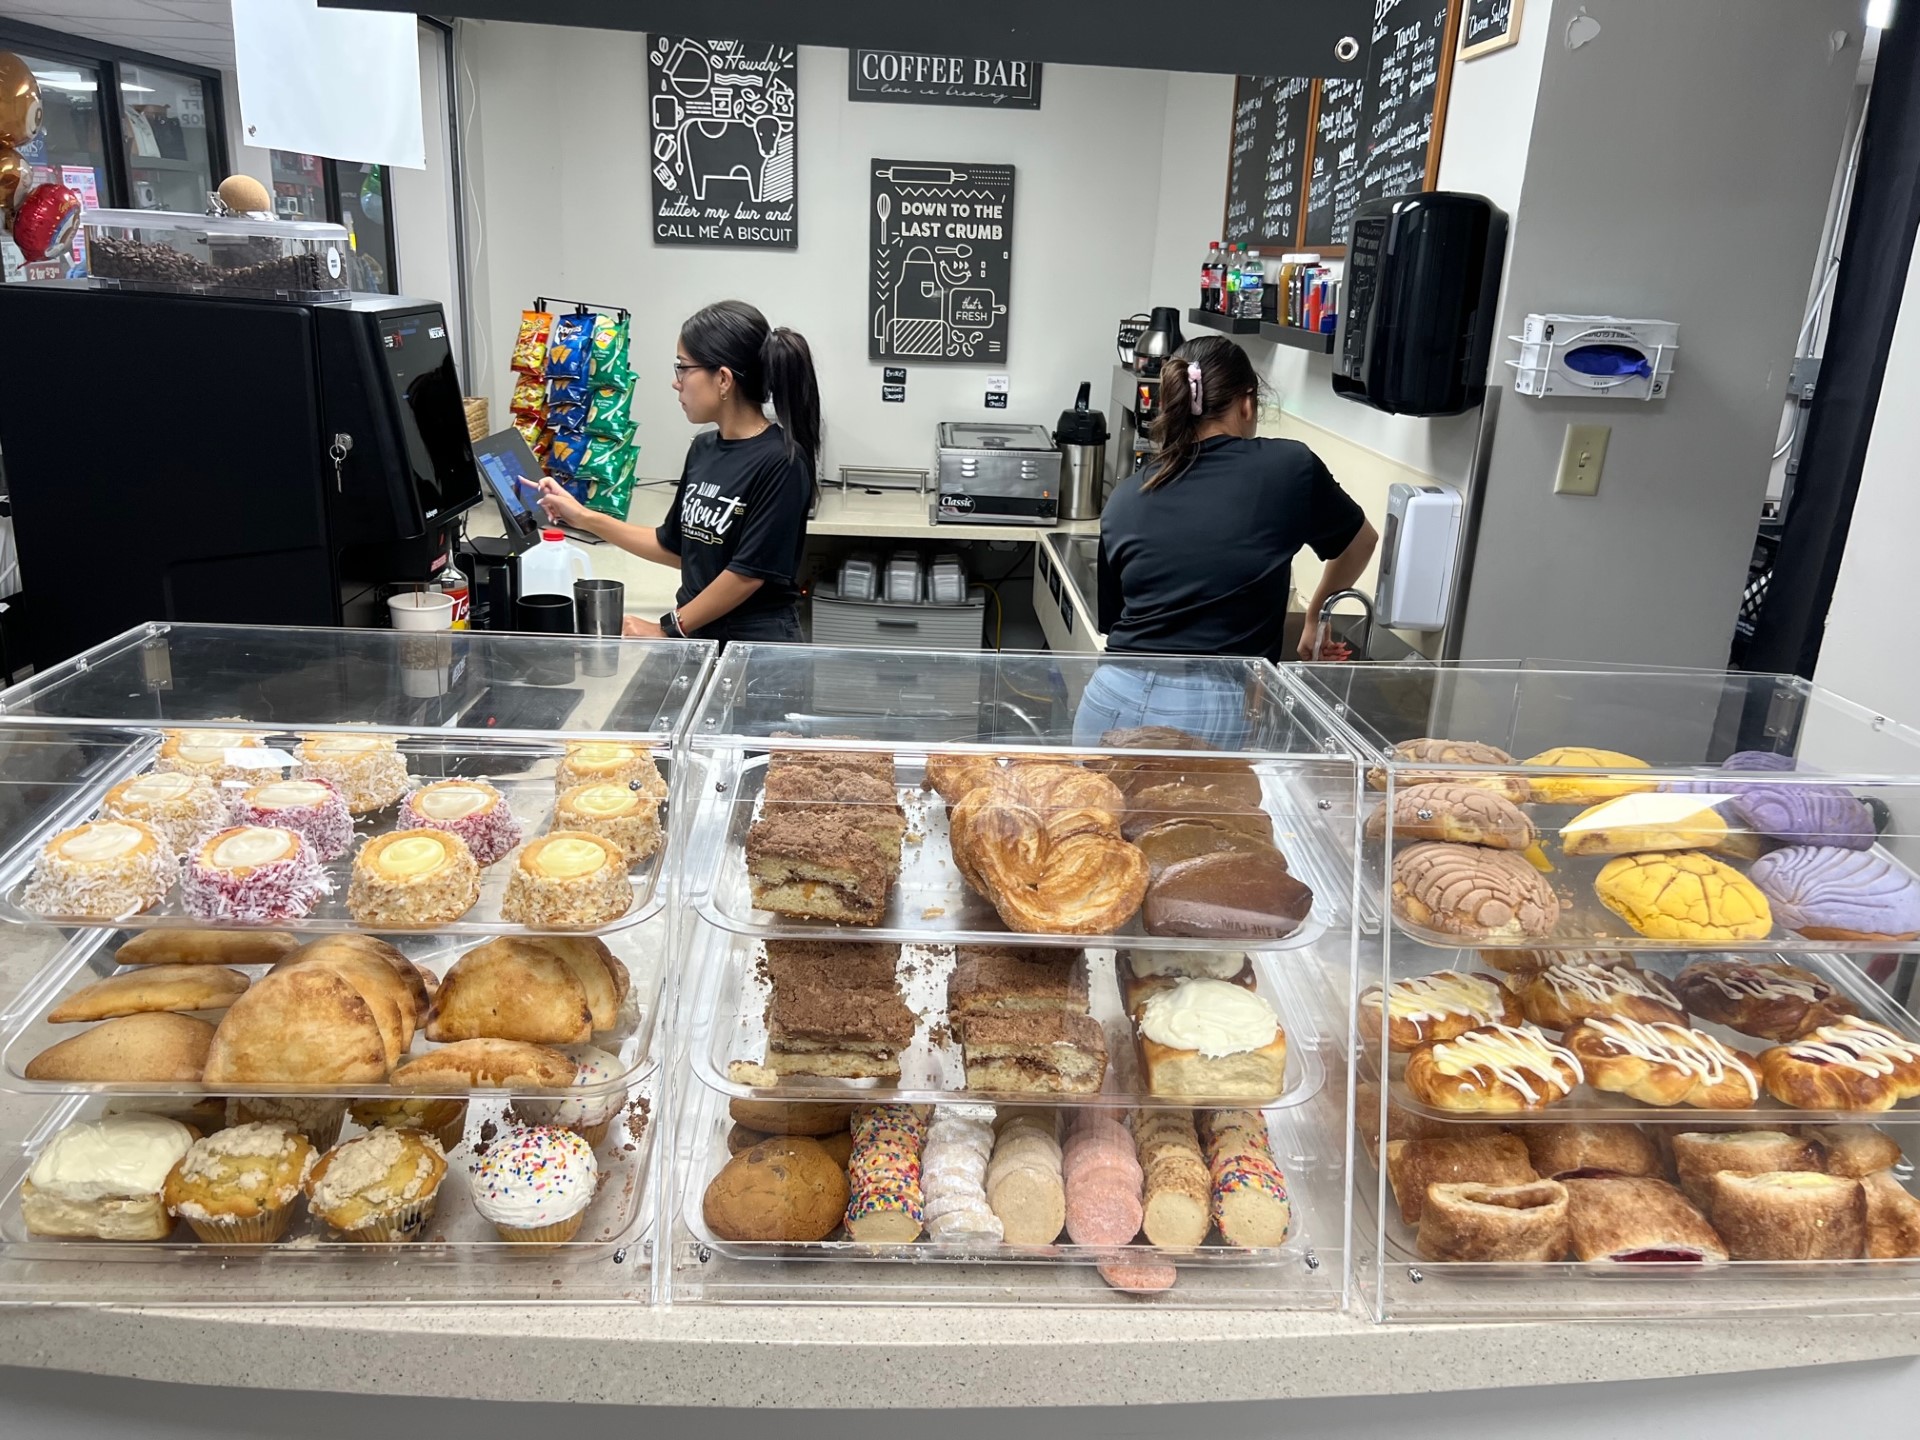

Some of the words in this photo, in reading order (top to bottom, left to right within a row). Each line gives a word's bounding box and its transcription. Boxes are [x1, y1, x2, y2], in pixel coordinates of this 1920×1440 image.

[725, 40, 781, 88] Howdy
[862, 53, 964, 84] COFFEE
[973, 59, 1028, 88] BAR
[945, 85, 1008, 104] brewing
[658, 195, 701, 217] butter
[704, 208, 730, 227] my
[734, 201, 761, 220] bun
[765, 203, 794, 221] and
[901, 202, 947, 216] DOWN
[951, 203, 970, 218] TO
[974, 204, 1003, 219] THE
[657, 224, 695, 238] CALL
[699, 225, 720, 239] ME
[723, 226, 734, 240] A
[738, 226, 793, 242] BISCUIT
[901, 221, 941, 238] LAST
[945, 223, 1003, 240] CRUMB
[956, 311, 988, 322] FRESH
[681, 483, 747, 535] Biscuit
[941, 496, 972, 507] Classic
